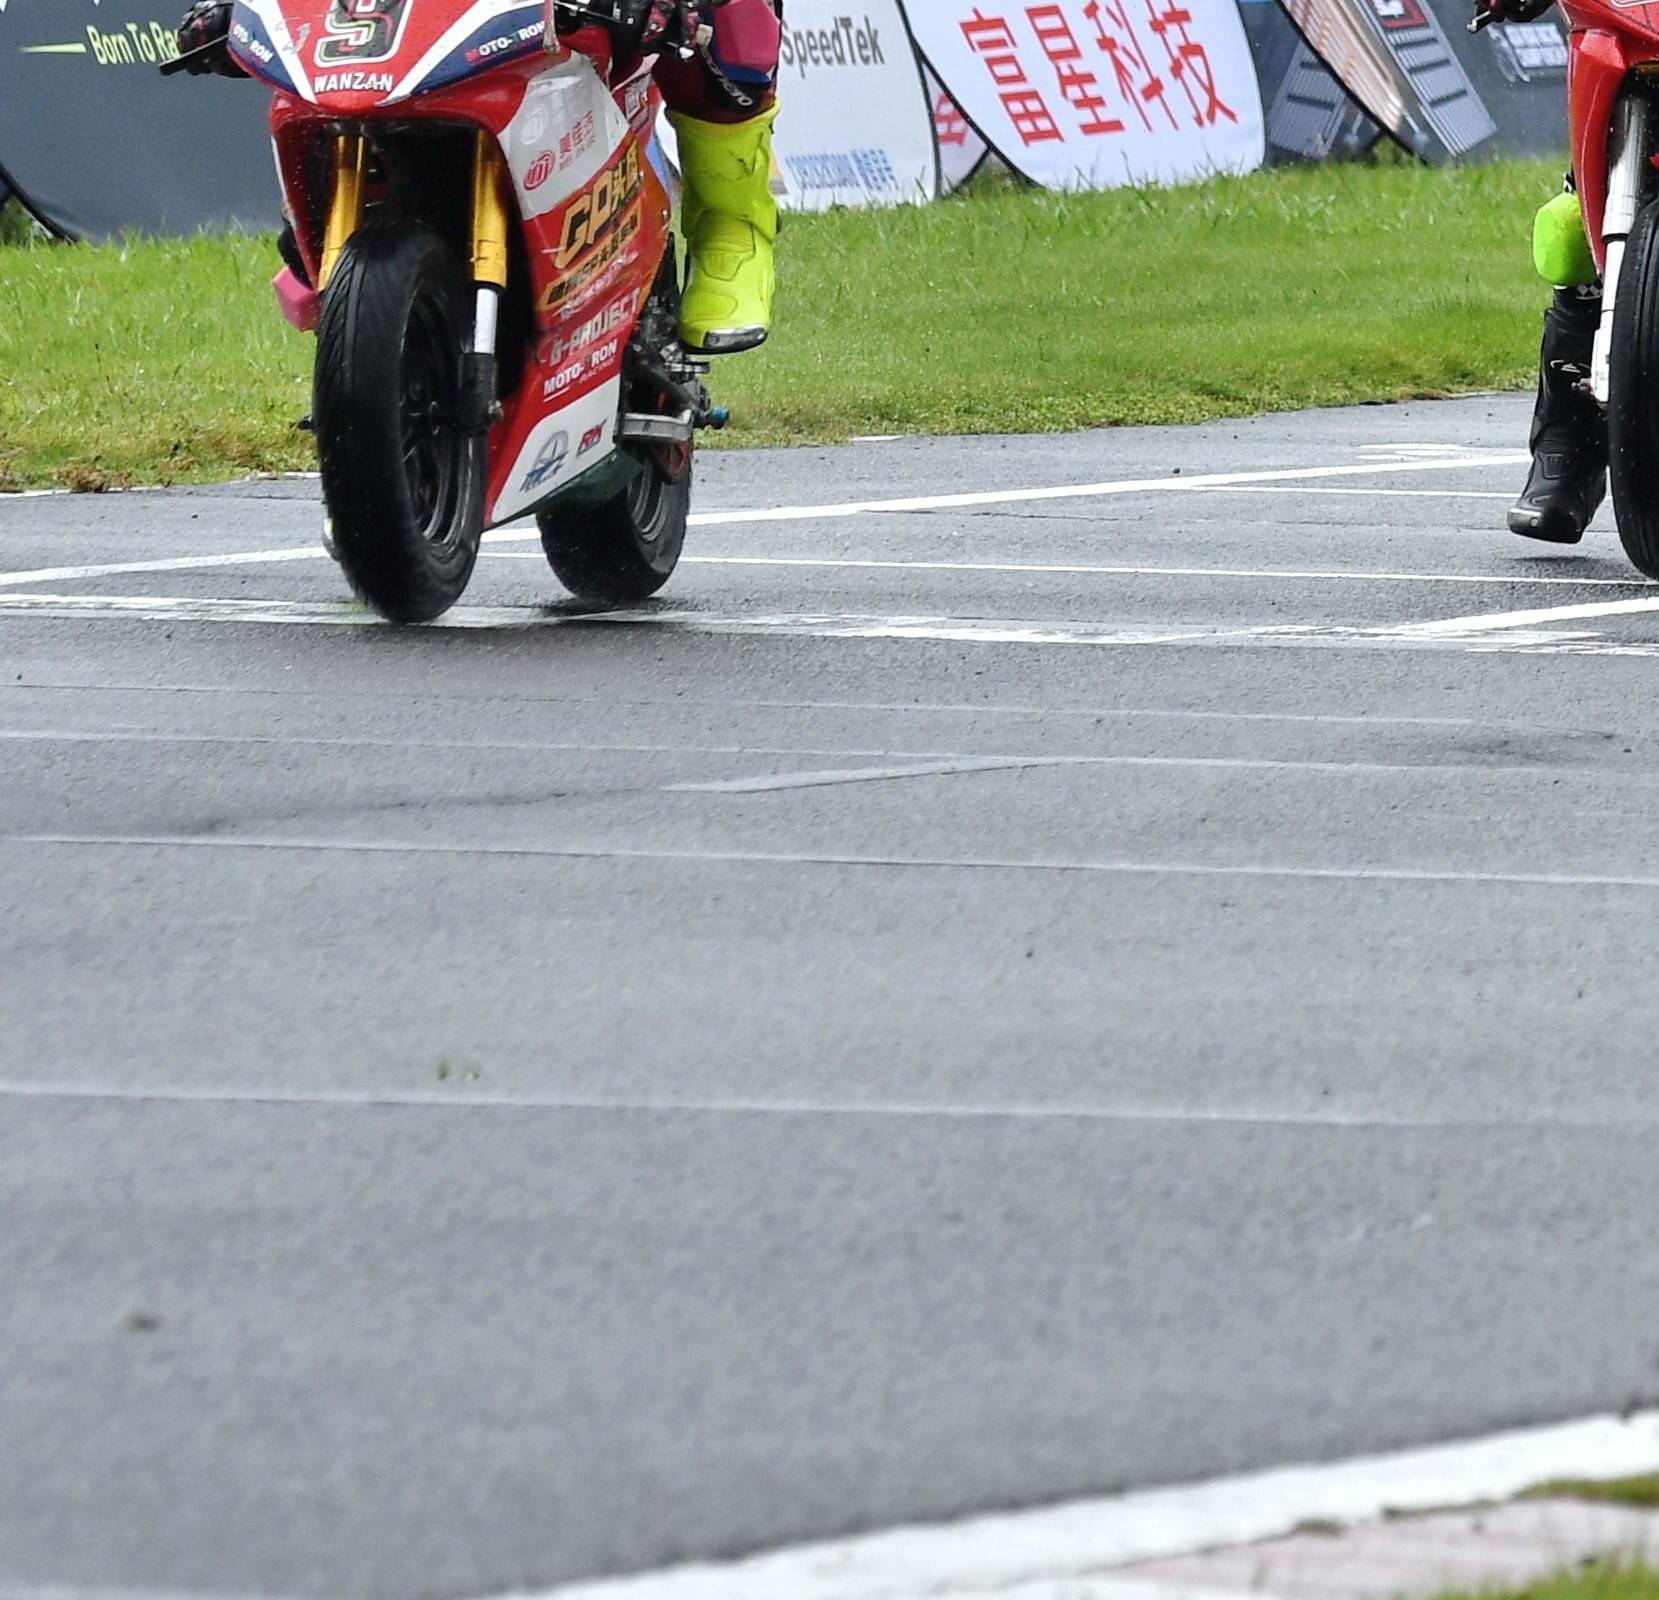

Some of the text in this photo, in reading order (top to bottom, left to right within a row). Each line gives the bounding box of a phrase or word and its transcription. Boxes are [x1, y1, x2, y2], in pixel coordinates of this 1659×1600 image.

[86, 20, 181, 65] Born To Ra
[314, 72, 394, 93] WANZAN
